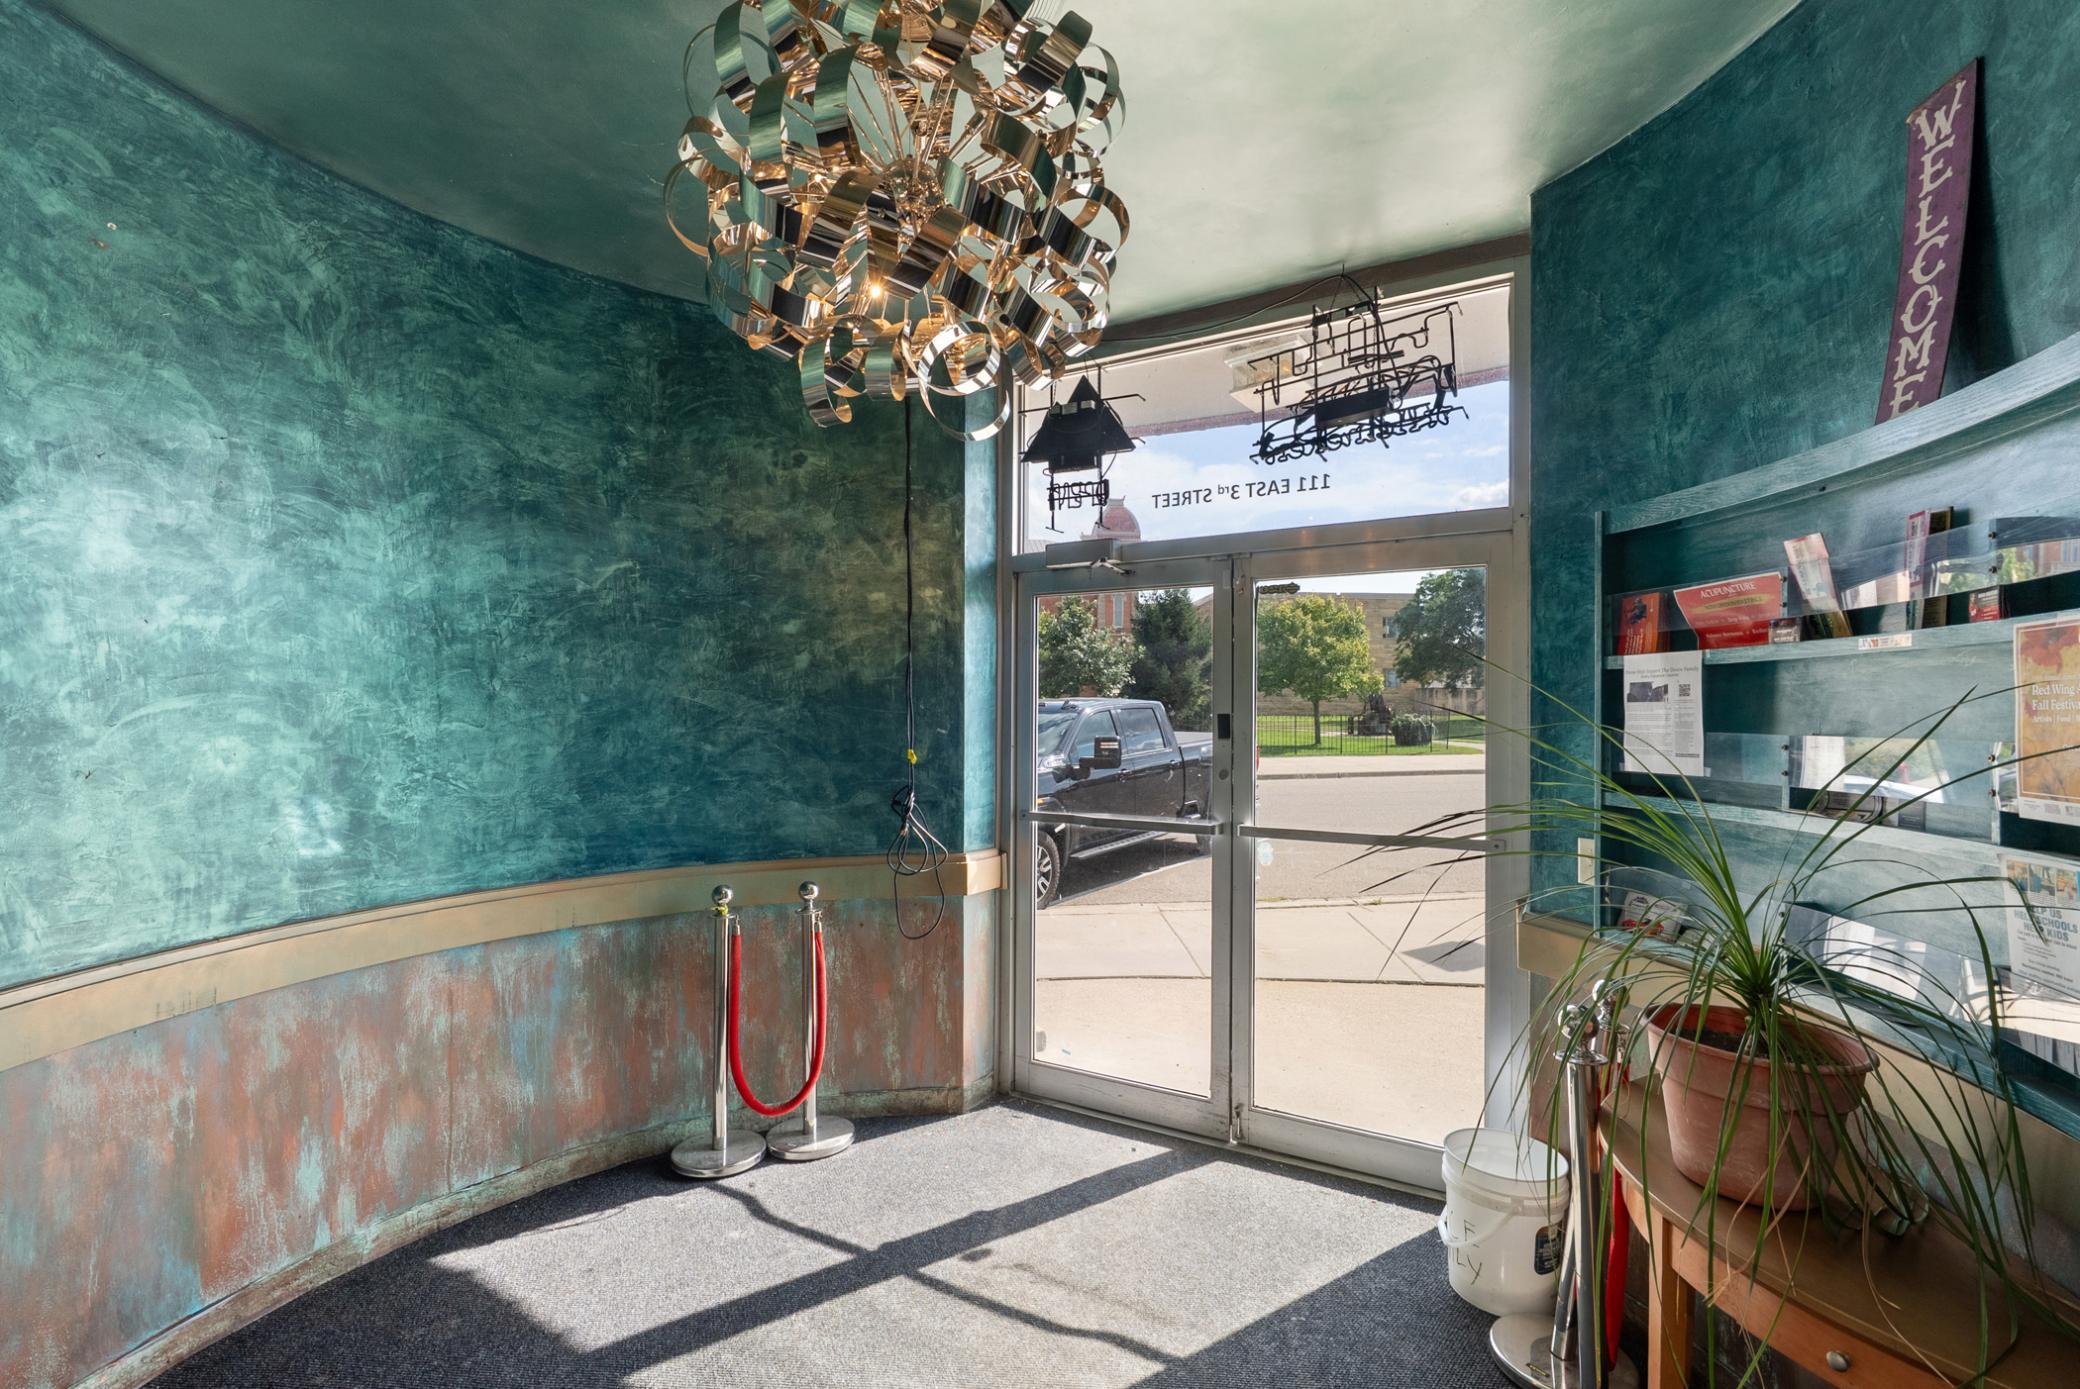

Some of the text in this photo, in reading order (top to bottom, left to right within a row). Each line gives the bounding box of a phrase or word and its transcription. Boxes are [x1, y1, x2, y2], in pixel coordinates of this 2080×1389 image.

[1888, 80, 1967, 419] WELCOME
[1700, 582, 1758, 599] ACUPUNCTURE
[2032, 683, 2076, 697] Red Wing
[2032, 699, 2049, 710] Fall
[2049, 908, 2063, 920] US
[2047, 928, 2069, 942] KIDS
